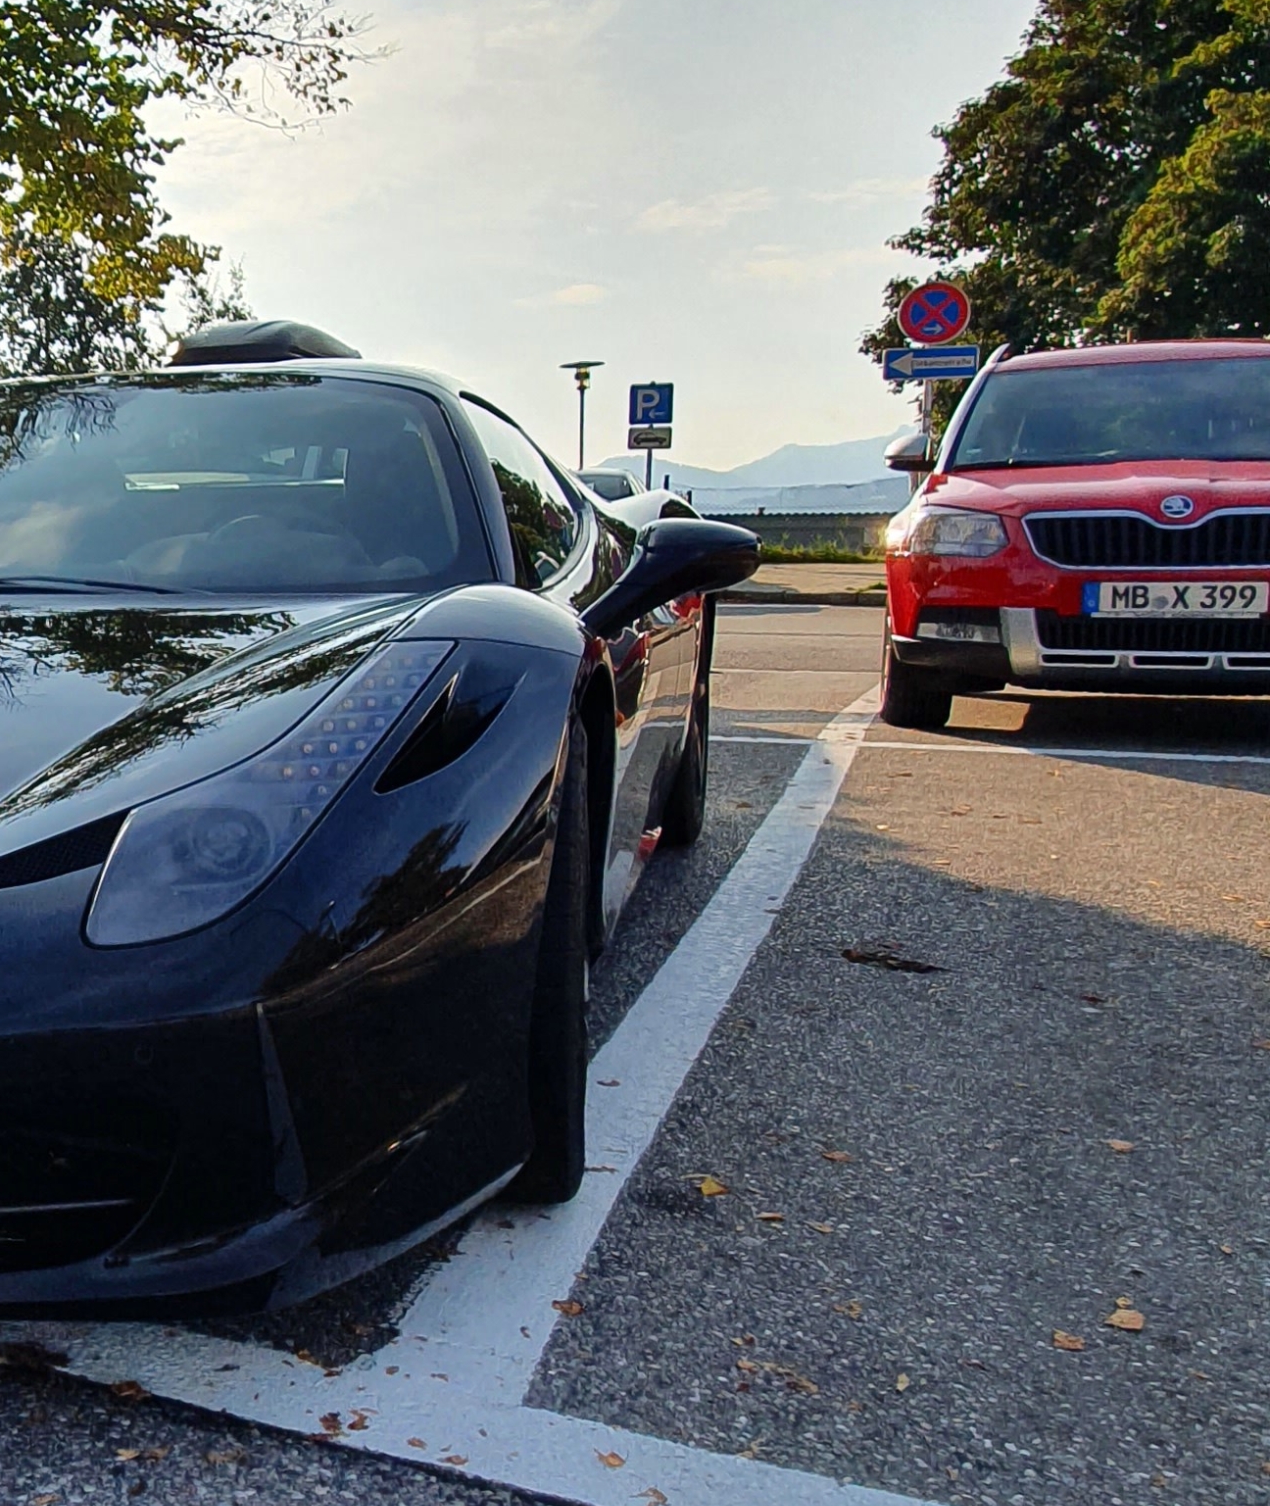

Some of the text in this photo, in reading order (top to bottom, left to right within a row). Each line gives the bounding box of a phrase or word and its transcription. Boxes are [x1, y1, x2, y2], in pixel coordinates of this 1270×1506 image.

[636, 389, 660, 420] P
[1111, 585, 1257, 609] MB X 399
